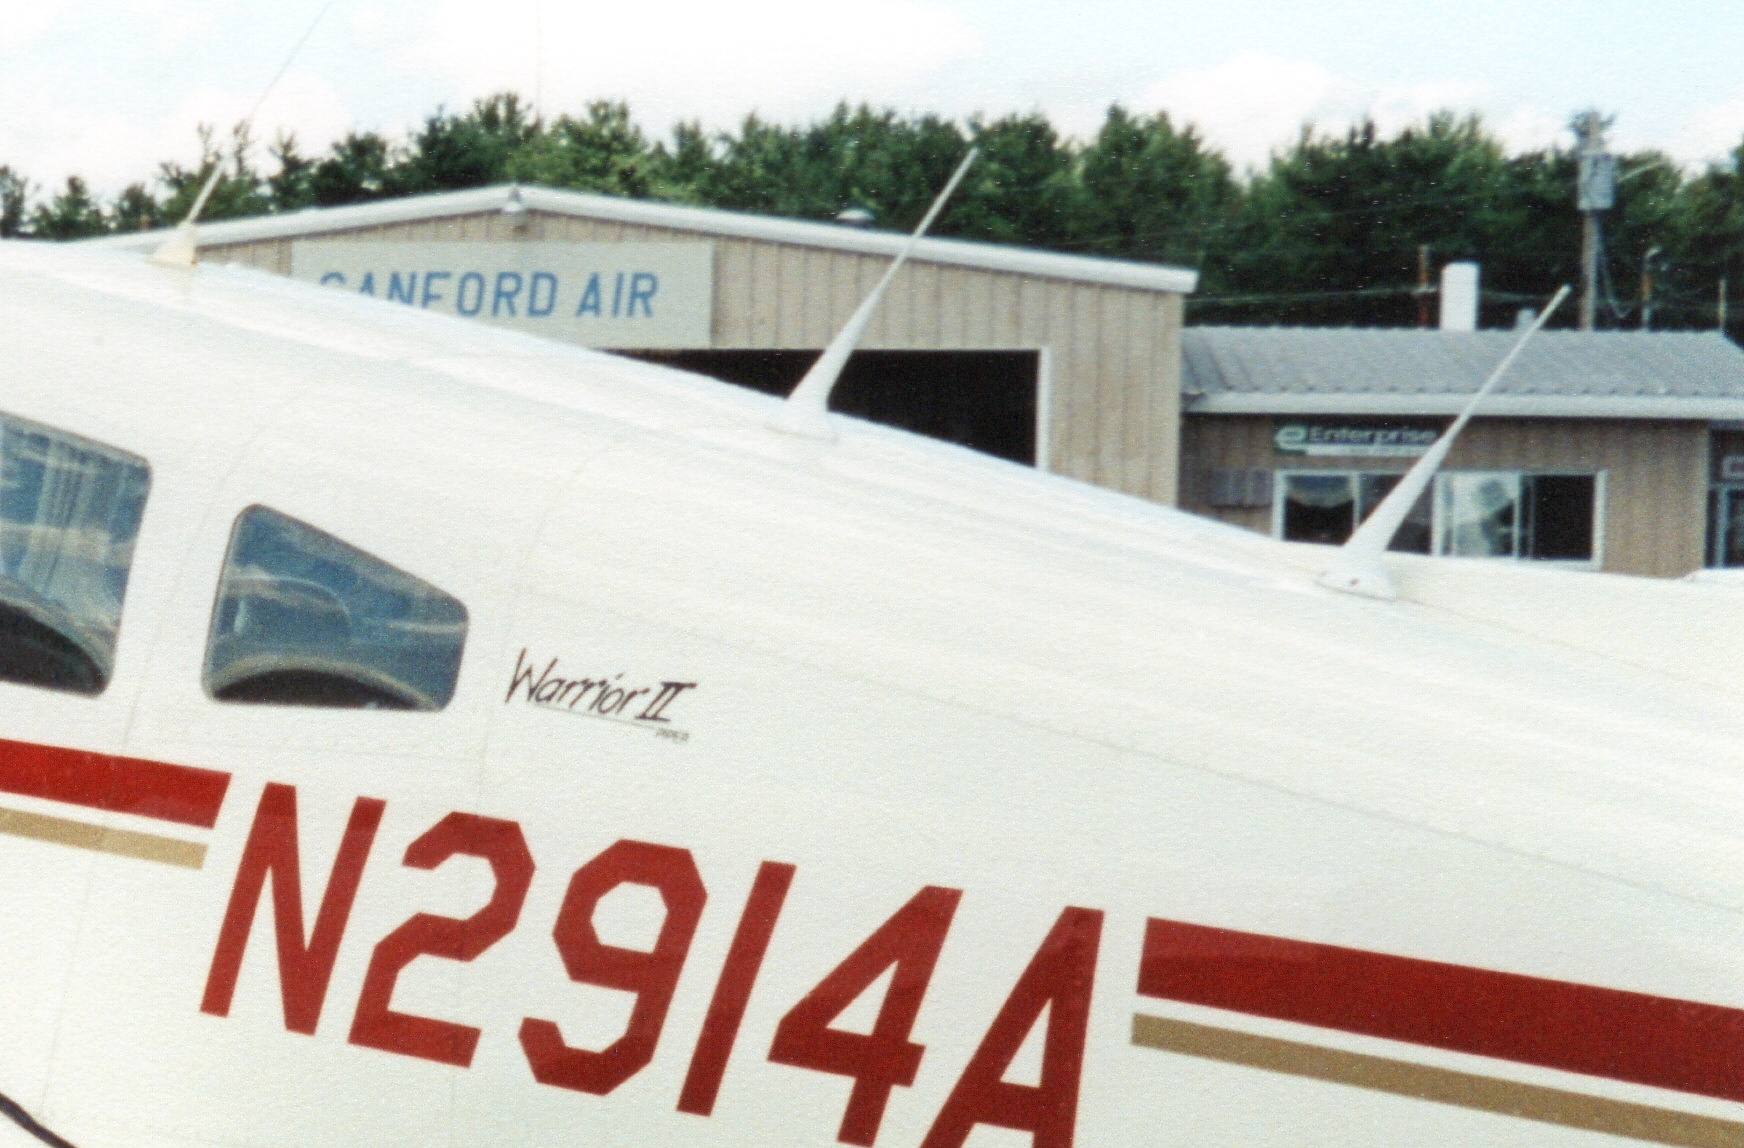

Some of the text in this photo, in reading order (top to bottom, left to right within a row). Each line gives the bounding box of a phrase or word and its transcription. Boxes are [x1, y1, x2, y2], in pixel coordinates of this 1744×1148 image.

[575, 271, 659, 318] AIR
[504, 647, 697, 722] Warrior II
